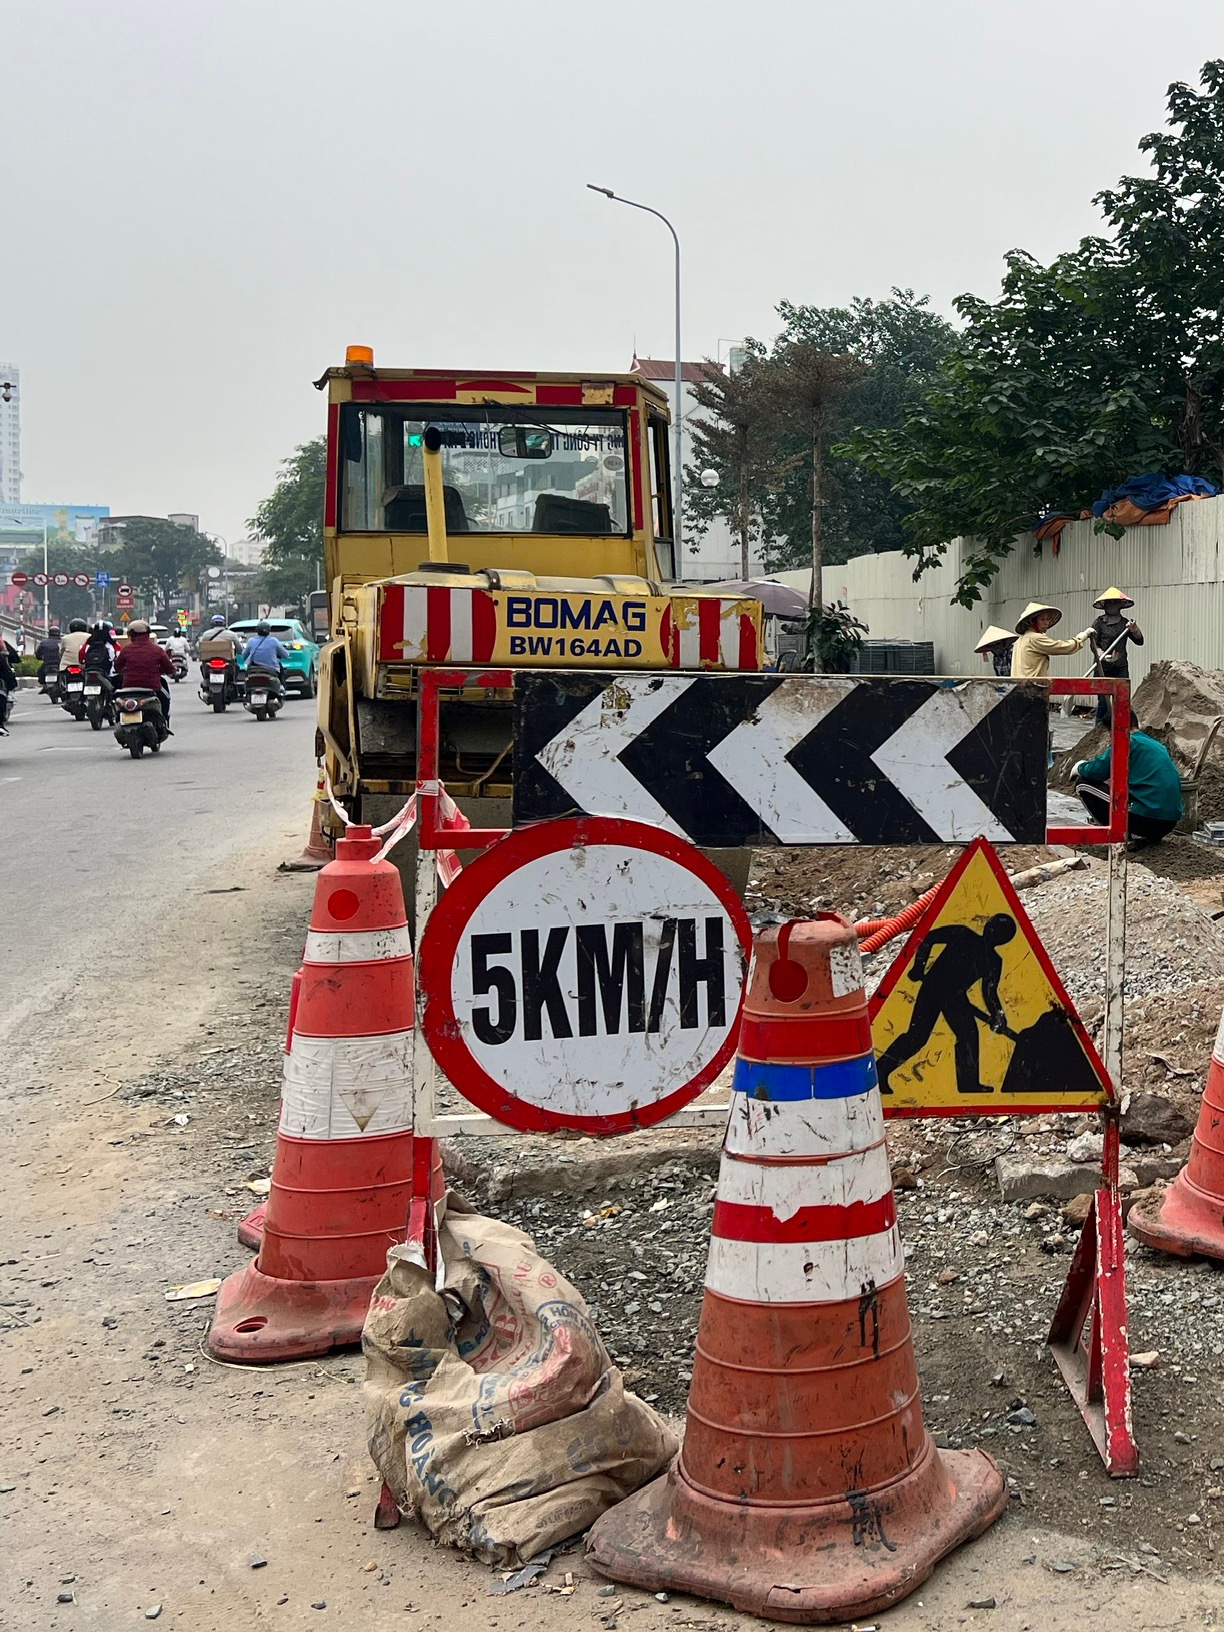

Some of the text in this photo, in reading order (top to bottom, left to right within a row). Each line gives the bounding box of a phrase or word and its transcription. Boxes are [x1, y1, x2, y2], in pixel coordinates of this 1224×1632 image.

[507, 597, 646, 631] BOMAG
[510, 636, 642, 657] BW164AD
[471, 916, 727, 1046] 5KM/H
